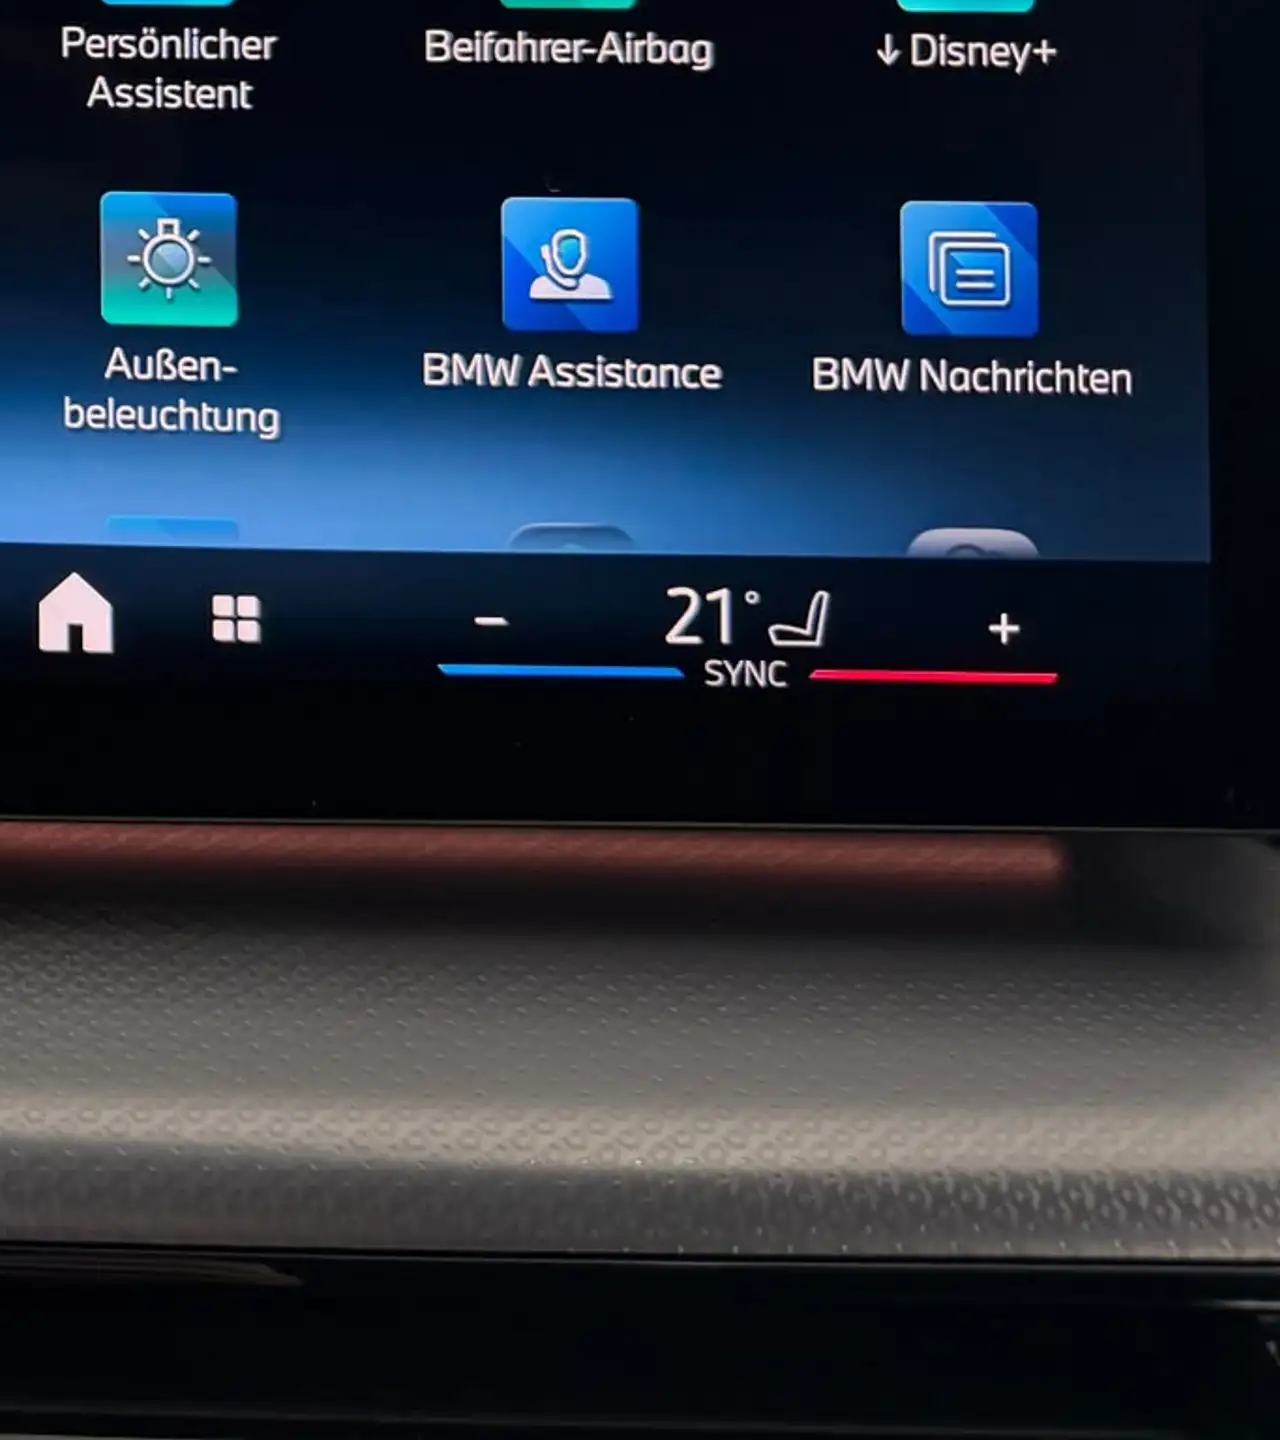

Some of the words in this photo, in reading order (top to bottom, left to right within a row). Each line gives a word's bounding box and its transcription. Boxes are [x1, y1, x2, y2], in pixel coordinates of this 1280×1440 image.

[62, 25, 278, 60] Persönlicher
[425, 29, 713, 72] Beifahrer-Airbag
[911, 33, 1057, 74] Disney+
[86, 75, 254, 110] Assistent
[104, 346, 237, 382] Außen-
[423, 352, 521, 387] BMW
[527, 354, 722, 389] Assistance
[813, 356, 911, 392] BMW
[920, 358, 1132, 395] Nachrichten
[64, 395, 280, 441] beleuchtung
[704, 659, 787, 688] SYNC
